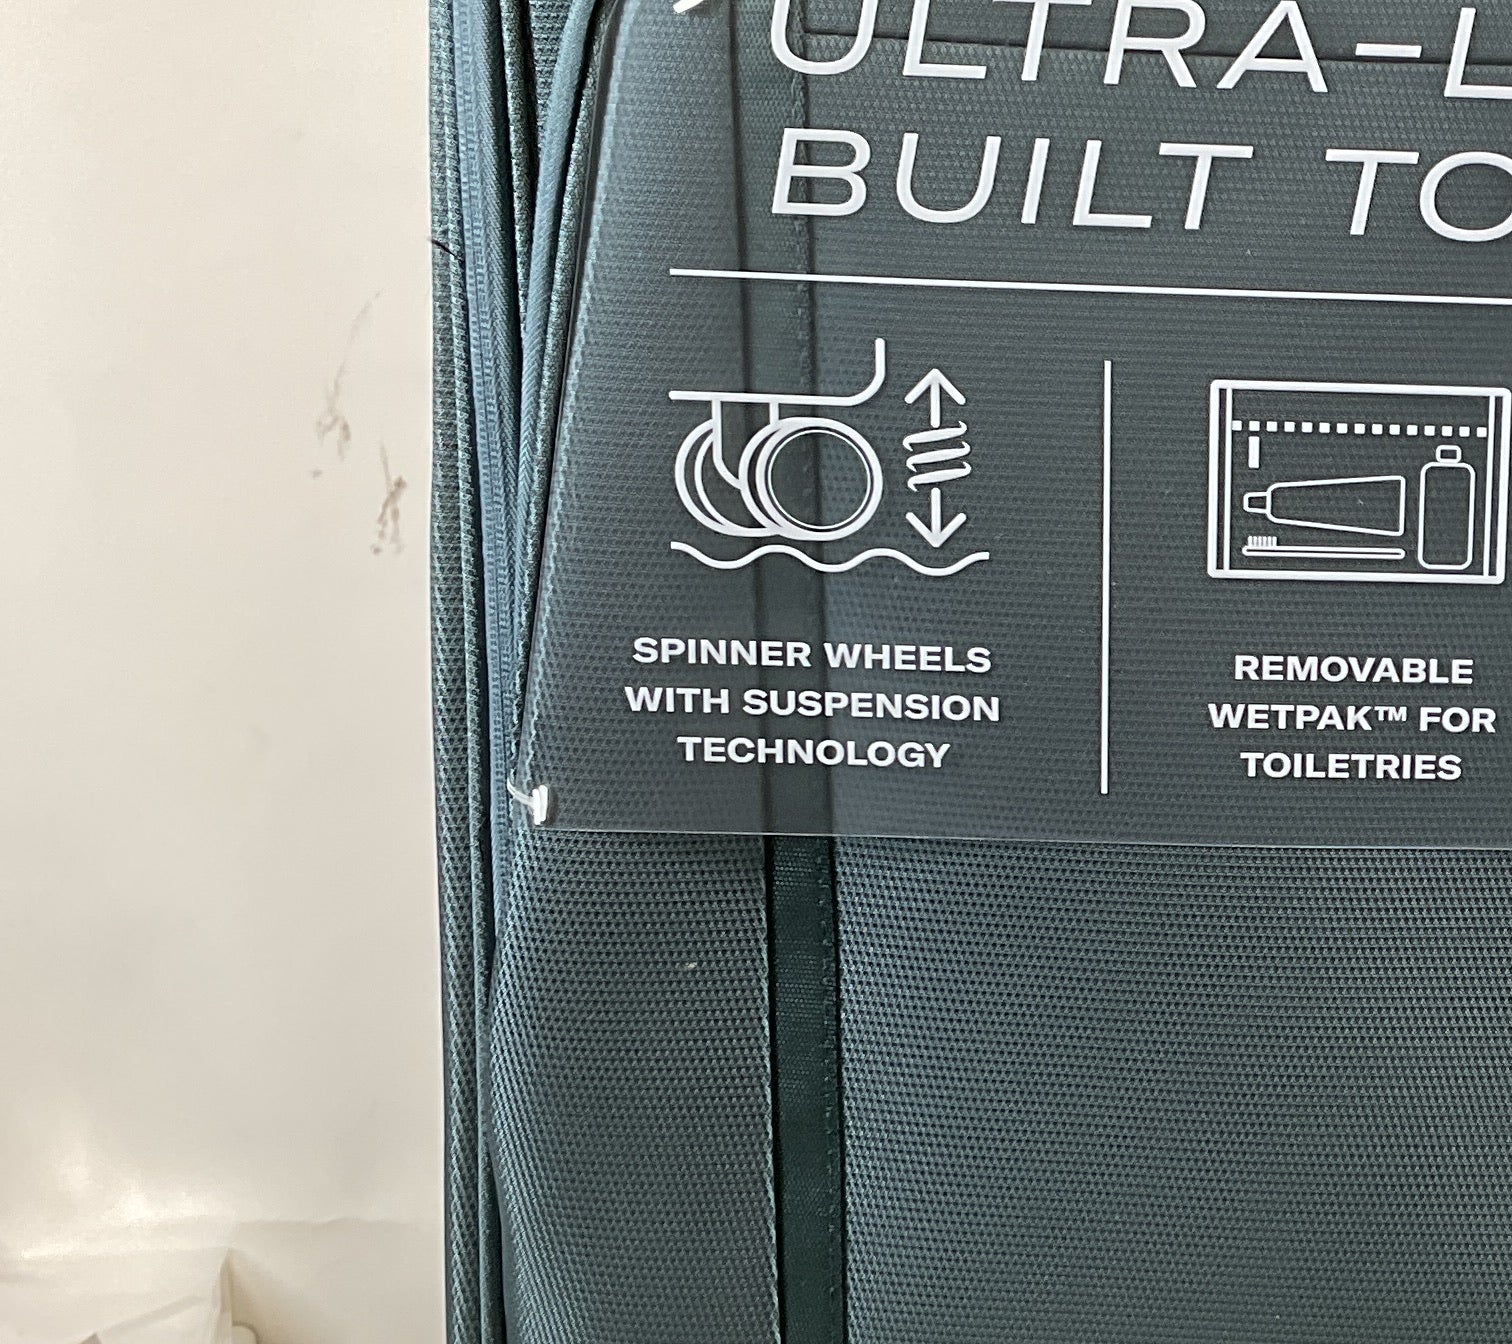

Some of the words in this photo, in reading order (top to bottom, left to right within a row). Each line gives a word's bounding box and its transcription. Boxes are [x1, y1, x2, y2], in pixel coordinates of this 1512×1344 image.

[770, 126, 1255, 231] BUILT
[631, 635, 813, 668] SPINNER
[822, 641, 993, 674] WHEELS
[1233, 653, 1475, 686] REMOVABLE
[623, 685, 731, 715] WITH
[741, 687, 1001, 723] SUSPENSION
[1418, 705, 1497, 734] FOR
[675, 735, 952, 769] TECHNOLOGY
[1238, 751, 1463, 782] TOILETRIES
